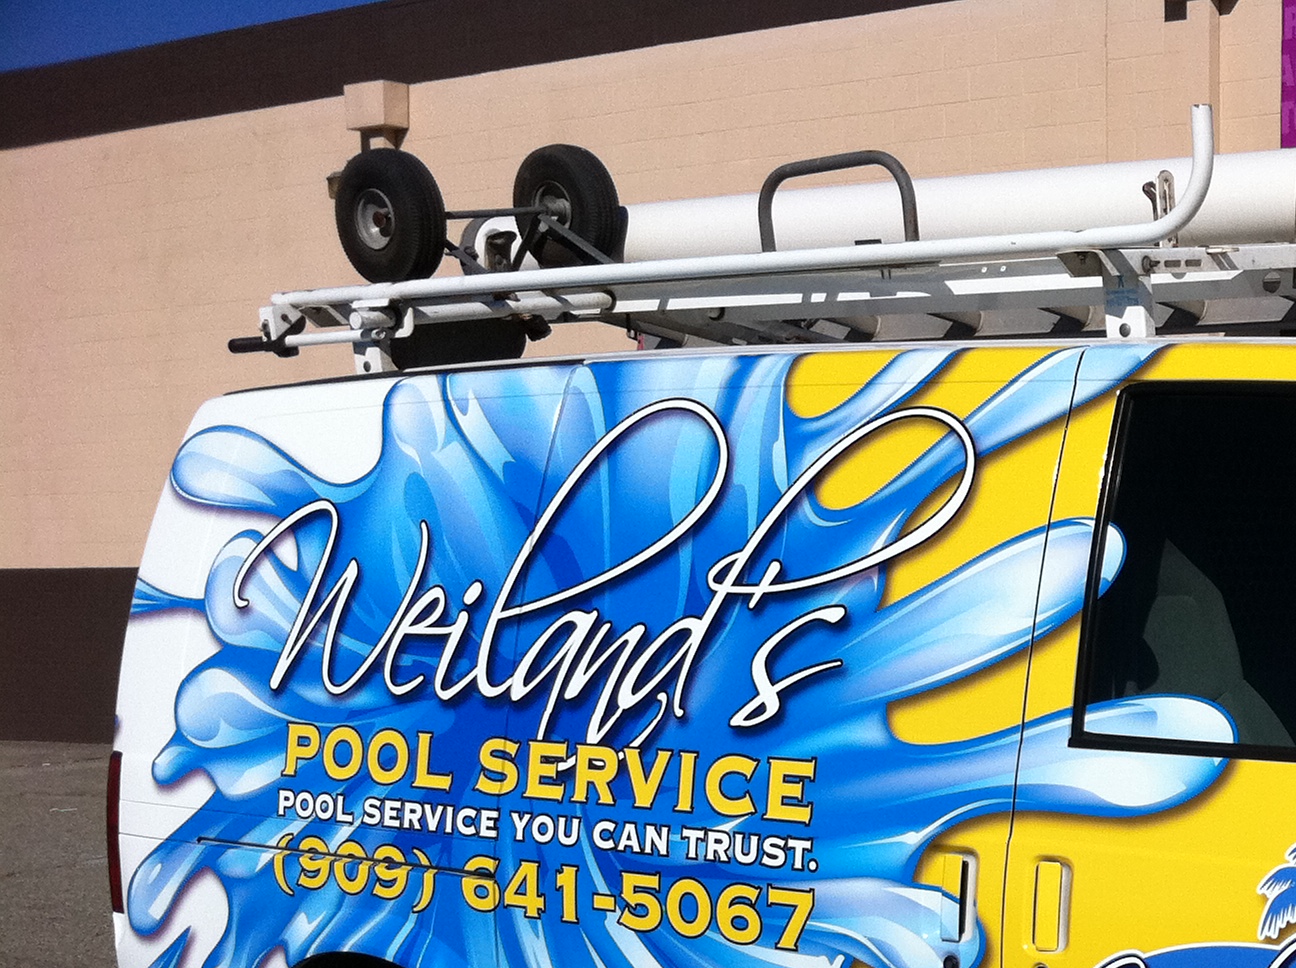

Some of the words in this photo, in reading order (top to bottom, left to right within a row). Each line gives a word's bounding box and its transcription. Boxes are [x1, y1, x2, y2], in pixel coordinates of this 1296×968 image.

[231, 397, 976, 772] Weiland's
[281, 723, 454, 793] POOL
[474, 738, 817, 825] SERVICE
[276, 789, 355, 823] POOL
[363, 798, 499, 839] SERVICE
[511, 811, 580, 847] YOU
[592, 821, 677, 857] CAN
[681, 828, 819, 873] TRUST.
[272, 833, 438, 914] (909)
[461, 855, 817, 952] 641-5067
